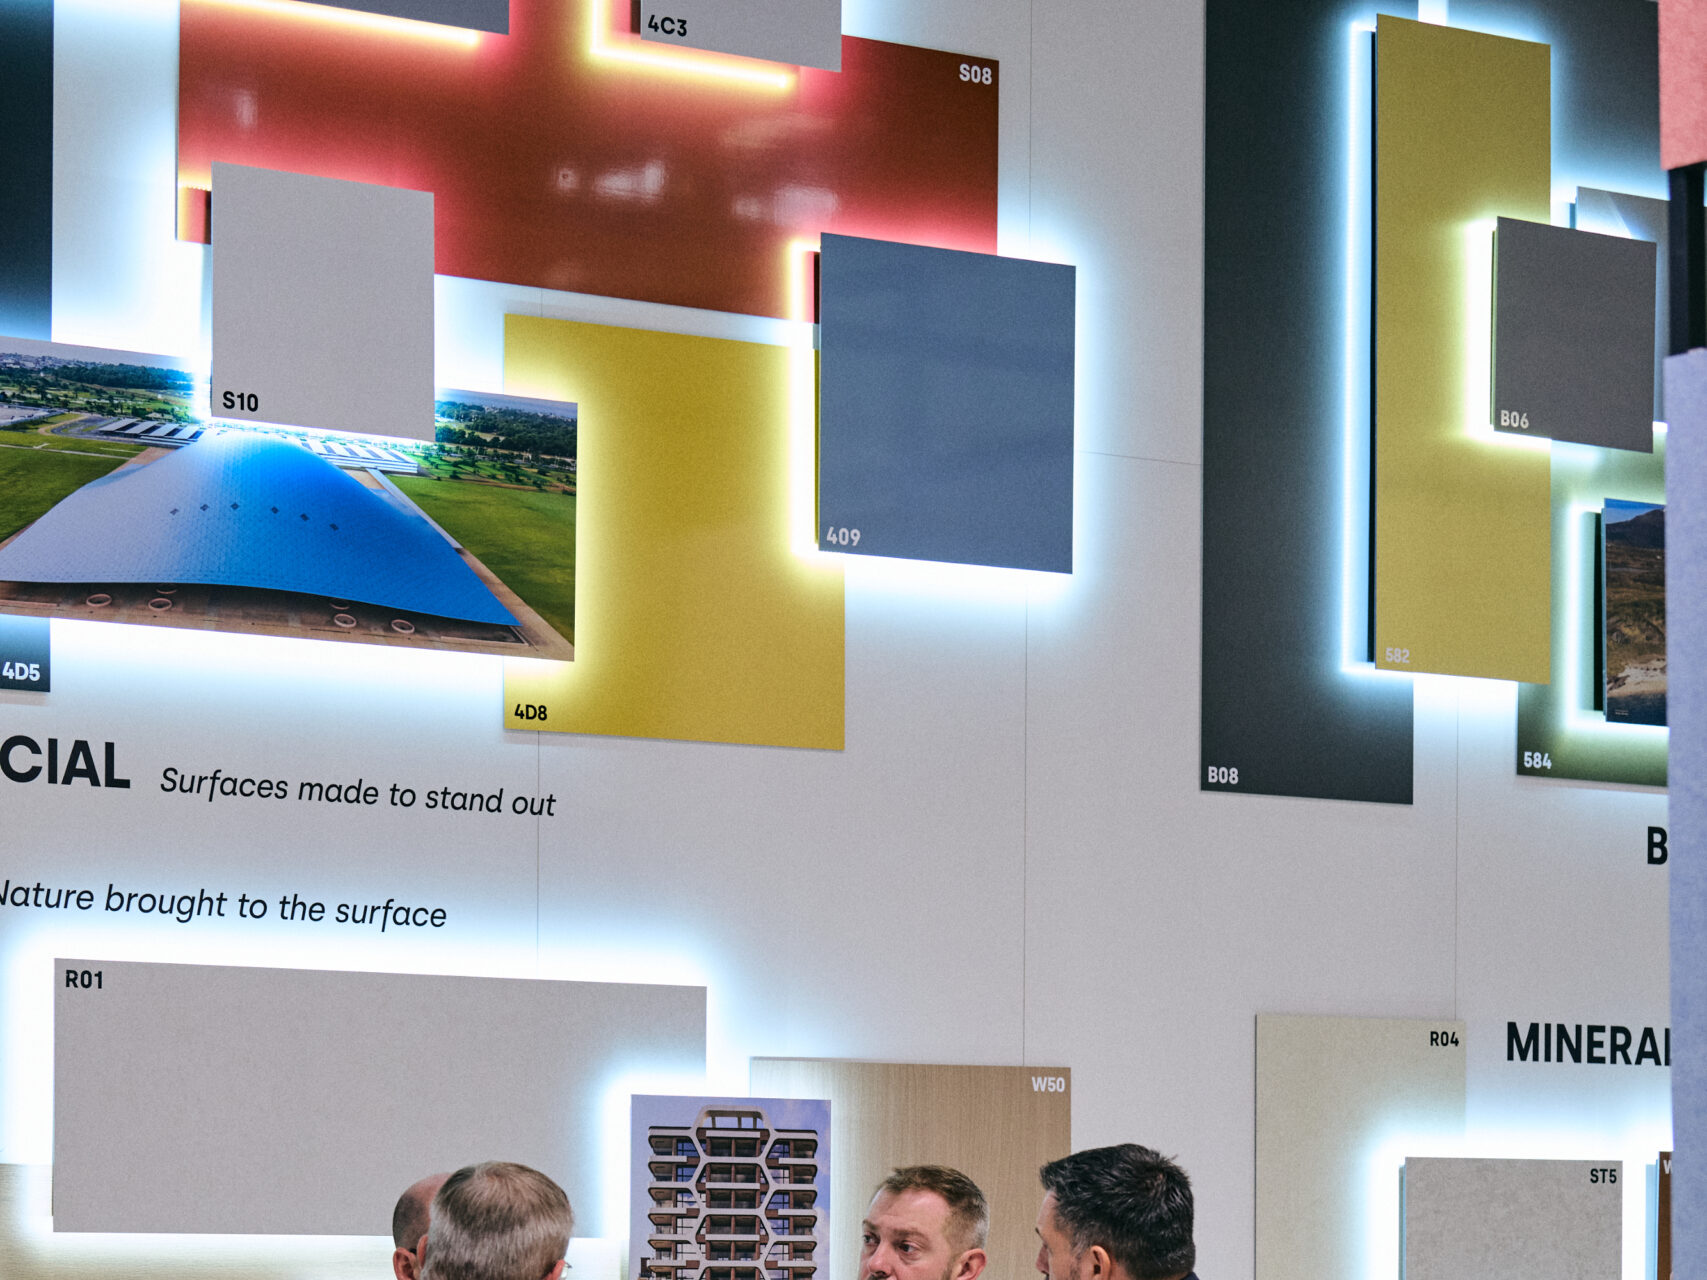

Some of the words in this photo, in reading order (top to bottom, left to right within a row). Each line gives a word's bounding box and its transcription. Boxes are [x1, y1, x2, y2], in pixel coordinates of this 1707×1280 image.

[648, 14, 688, 37] 4C3
[959, 63, 992, 85] S08
[222, 391, 259, 412] S10
[1500, 410, 1530, 429] B06
[826, 526, 861, 546] 409
[1385, 647, 1410, 664] 582
[2, 661, 41, 682] 4D5
[514, 704, 548, 721] 4D8
[0, 735, 131, 789] CIAL
[1523, 751, 1552, 770] 584
[1208, 766, 1239, 785] B08
[160, 767, 288, 803] Surfaces
[298, 778, 379, 805] made
[389, 783, 417, 807] to
[425, 786, 504, 813] stand
[512, 793, 557, 817] out
[105, 884, 228, 923] brought
[238, 893, 268, 919] to
[279, 893, 326, 922] the
[335, 898, 447, 933] surface
[65, 969, 103, 990] R01
[1430, 1030, 1460, 1047] R04
[1031, 1076, 1066, 1093] W50
[1590, 1168, 1617, 1185] ST5
